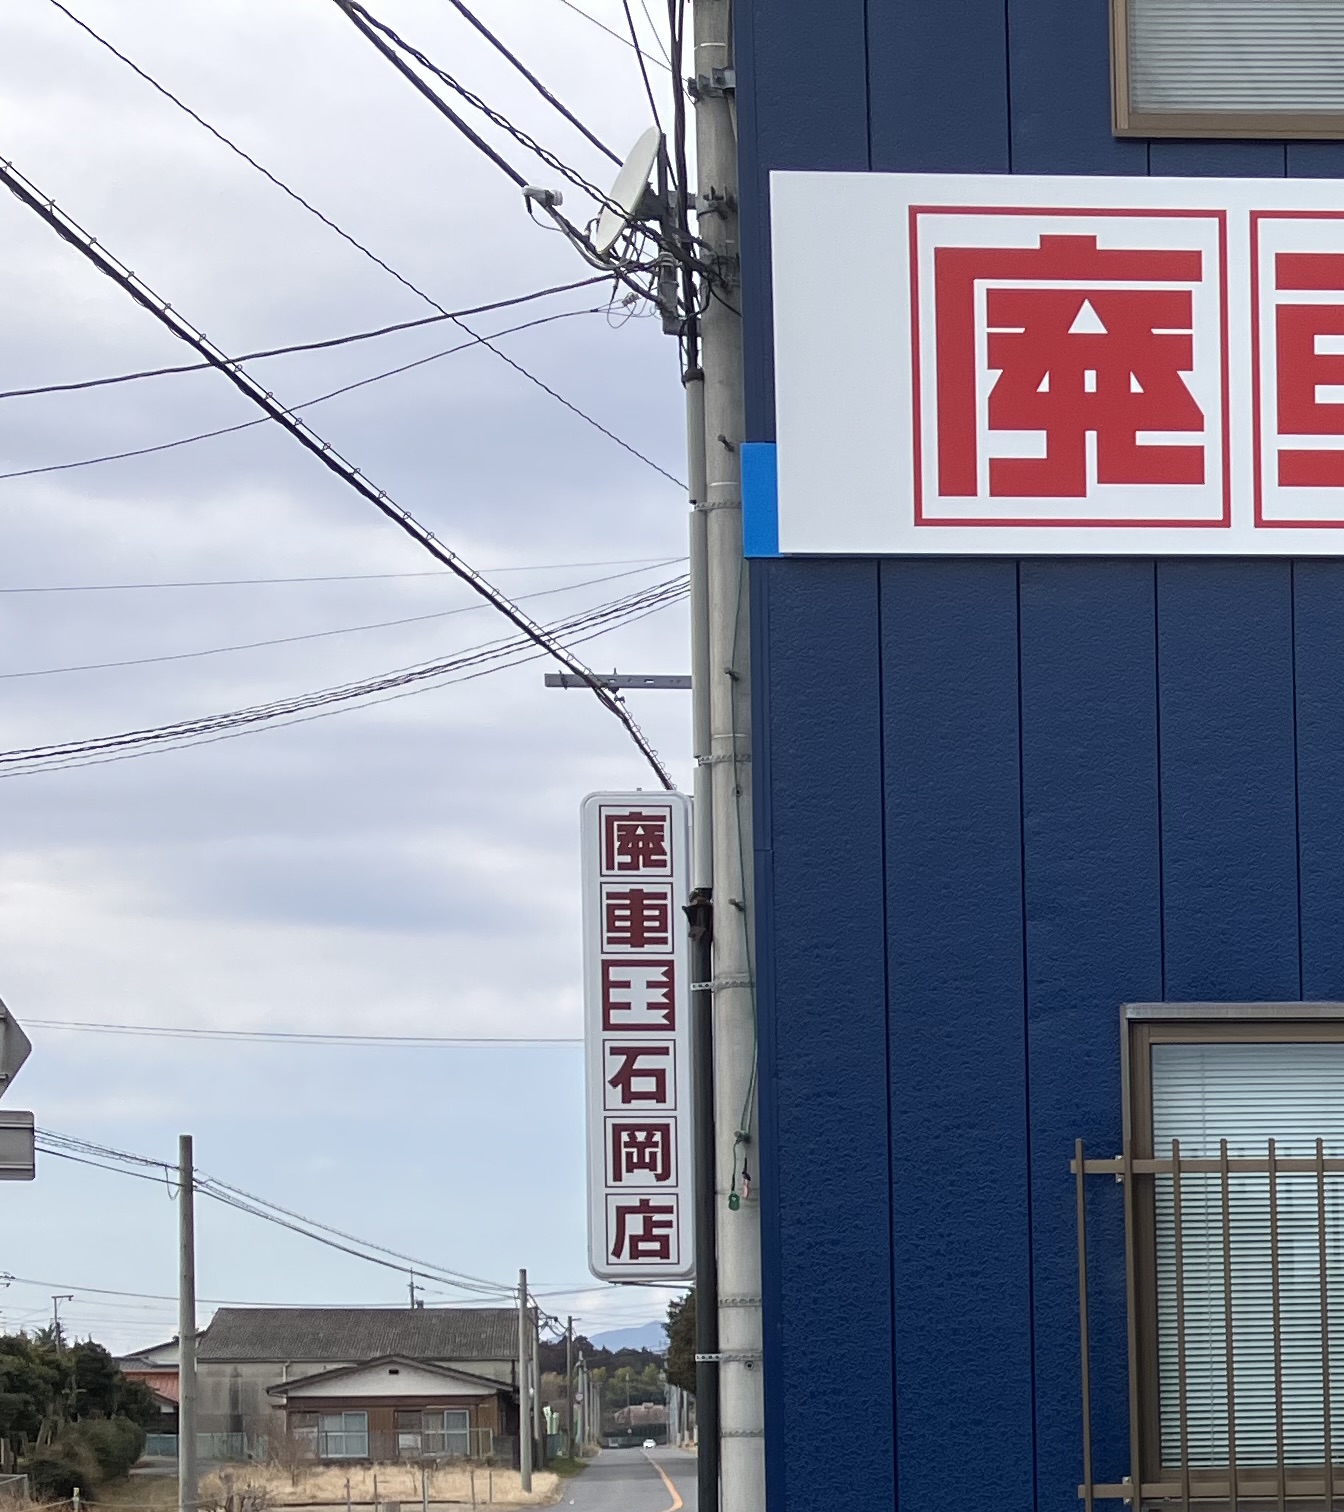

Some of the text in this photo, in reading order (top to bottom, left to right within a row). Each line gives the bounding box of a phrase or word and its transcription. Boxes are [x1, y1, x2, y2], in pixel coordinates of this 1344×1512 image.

[602, 810, 676, 1260] 廃車王石岡店
